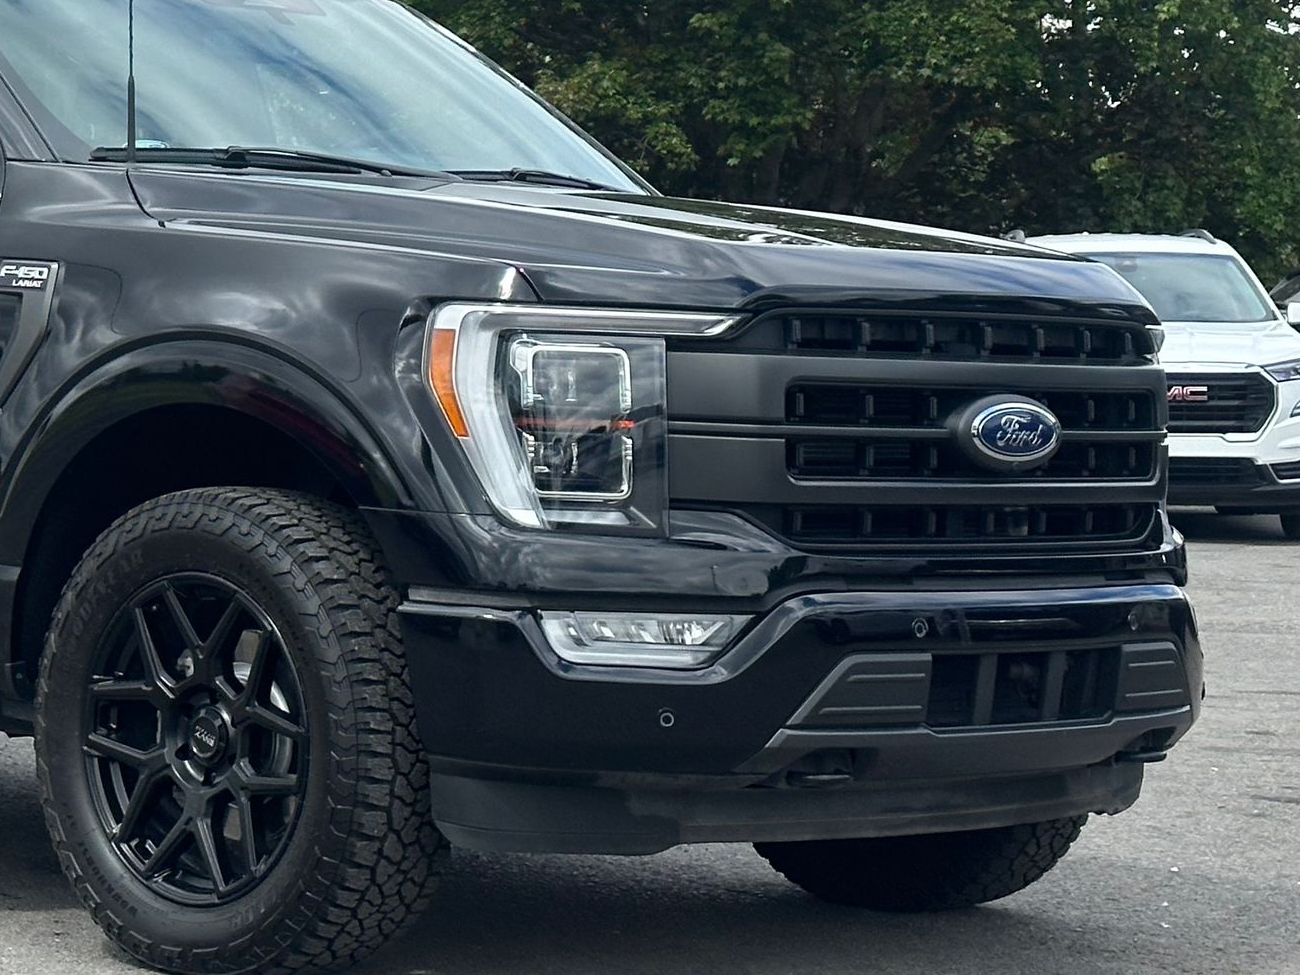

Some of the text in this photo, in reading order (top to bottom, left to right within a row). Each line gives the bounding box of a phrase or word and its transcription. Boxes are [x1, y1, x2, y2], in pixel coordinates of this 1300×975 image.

[0, 265, 49, 280] F-150
[12, 279, 43, 288] LARIAT
[1166, 386, 1208, 401] MC
[996, 414, 1044, 447] Ford
